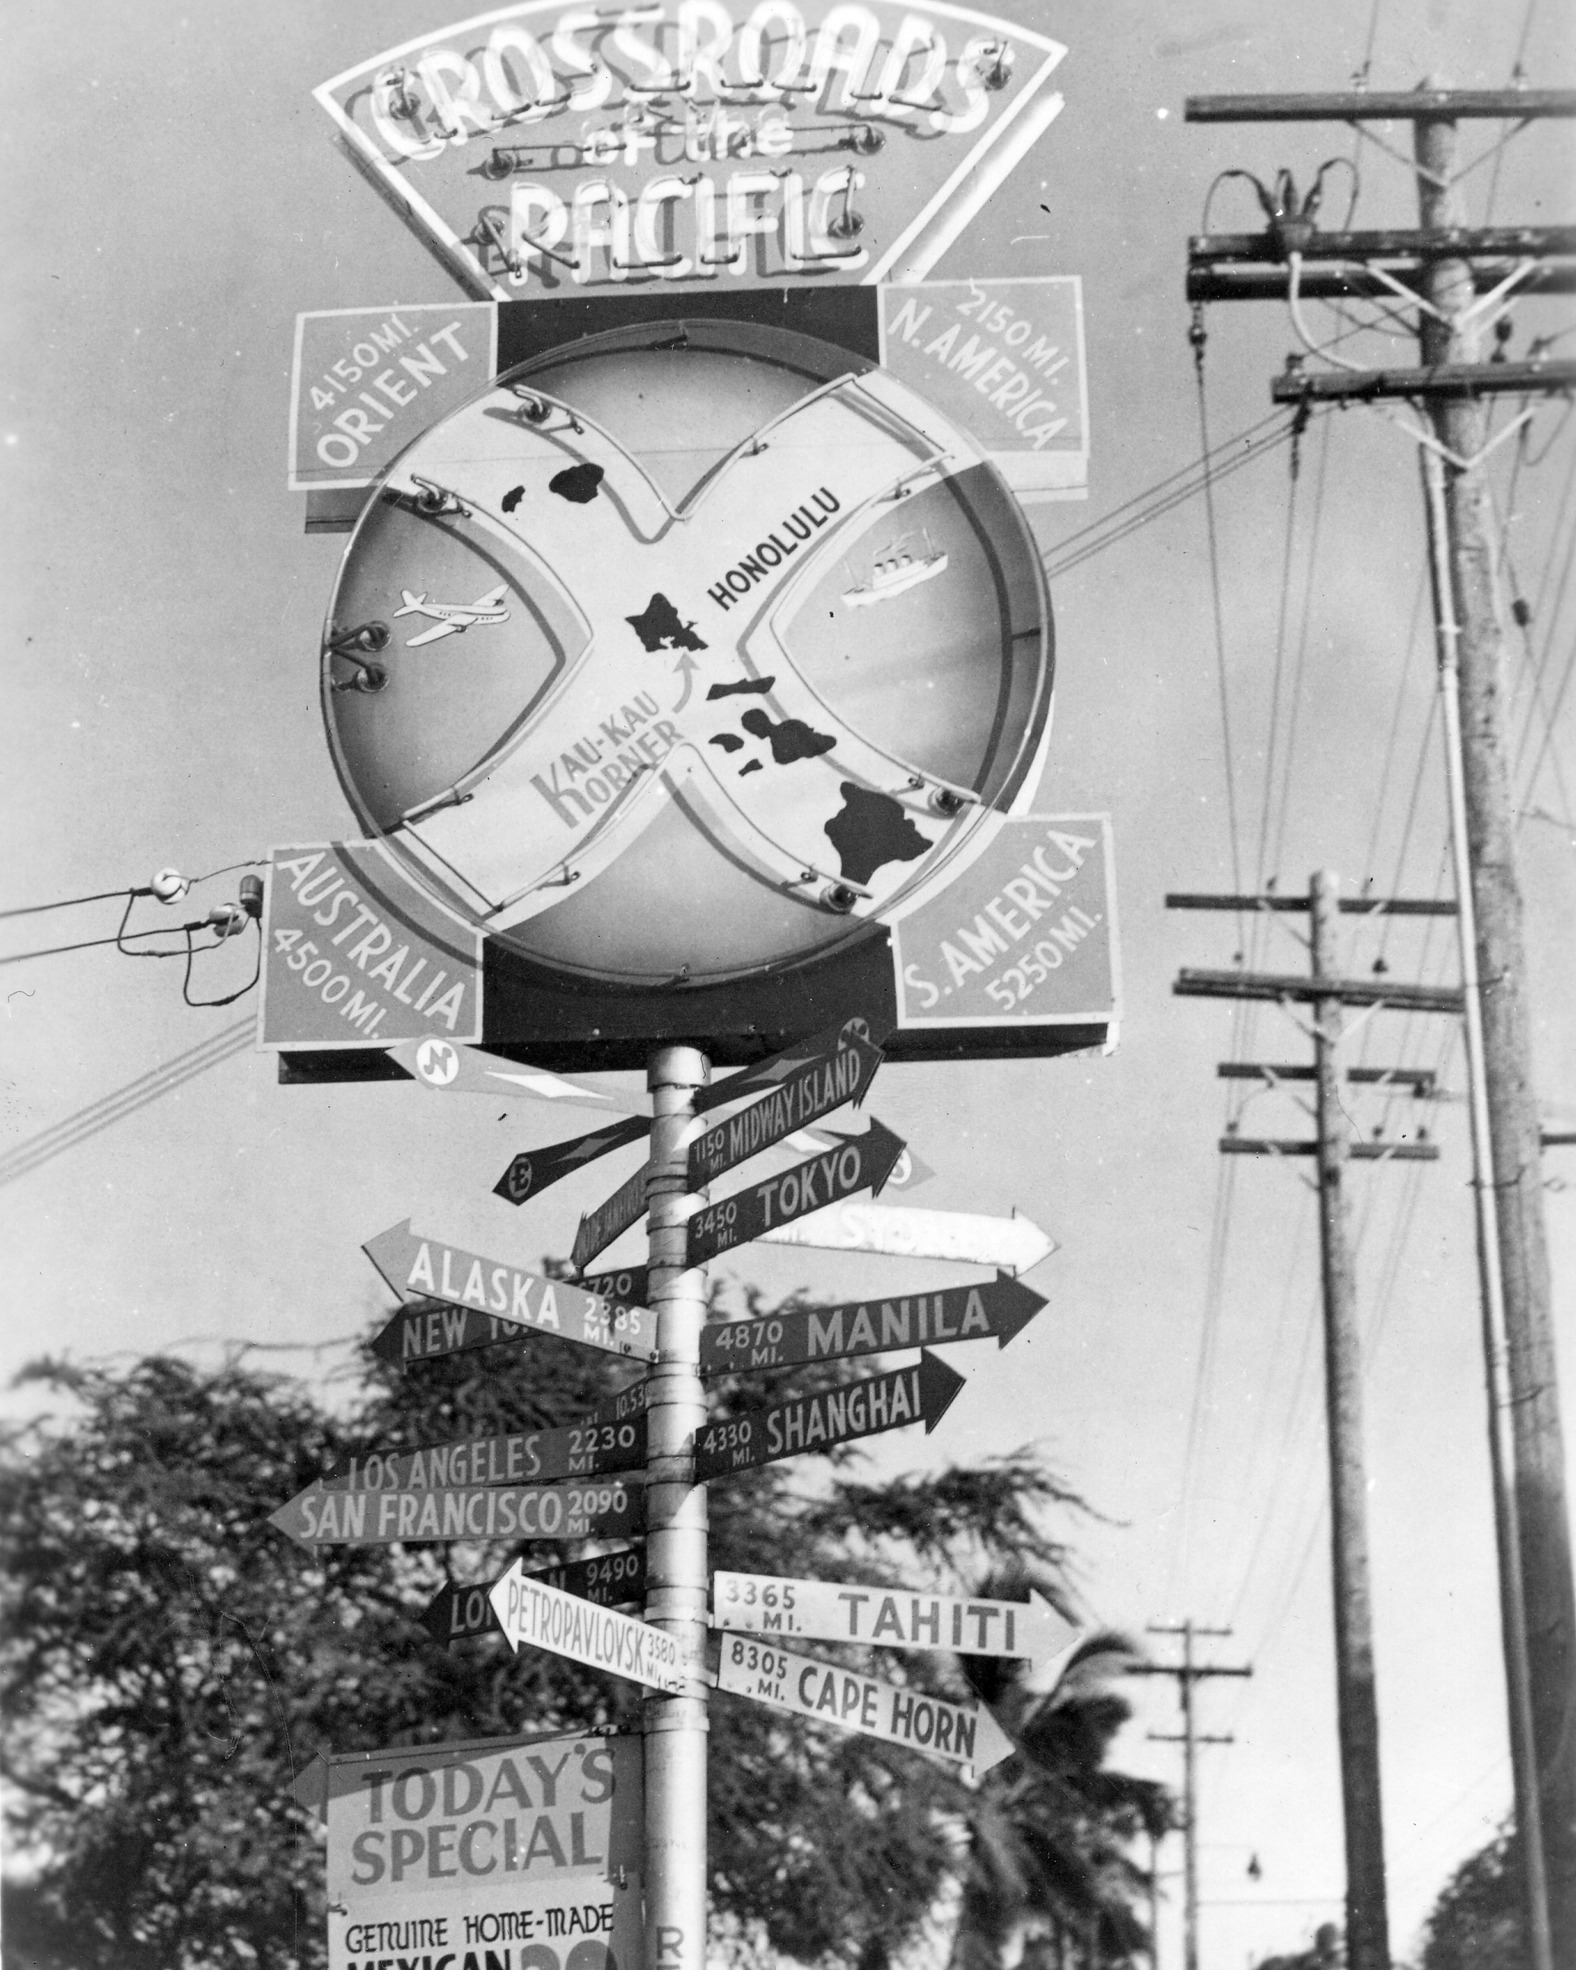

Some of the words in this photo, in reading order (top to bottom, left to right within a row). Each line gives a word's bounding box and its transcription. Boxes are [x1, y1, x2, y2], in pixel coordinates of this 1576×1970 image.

[370, 0, 1016, 161] CROSSROADS
[583, 103, 657, 166] of
[685, 103, 794, 162] the
[509, 170, 869, 286] PACIFIC
[955, 287, 1032, 346] 2150
[1021, 335, 1070, 386] MI.
[309, 342, 379, 410] 4150
[317, 321, 469, 468] ORIENT
[923, 323, 1068, 450] AMERICA
[706, 487, 841, 611] HONOLULU
[276, 852, 465, 1031] AUSTRALIA
[940, 829, 1098, 987] AMERICA
[273, 929, 350, 1004] 4500
[984, 940, 1063, 1011] 5250
[1049, 905, 1103, 951] MI.
[695, 1128, 725, 1163] 1150
[730, 1083, 795, 1161] MIDWAY
[799, 1048, 861, 1120] ISLAND
[695, 1201, 737, 1239] 3450
[757, 1146, 862, 1227] TOKYO
[710, 1154, 727, 1174] MI.
[717, 1228, 737, 1249] MI.
[406, 1242, 560, 1330] ALASKA
[584, 1297, 641, 1335] 2385
[715, 1320, 784, 1350] 4870
[807, 1288, 991, 1356] MANILA
[403, 1308, 468, 1358] NEW
[583, 1322, 614, 1346] MI.
[751, 1348, 784, 1366] MI.
[703, 1420, 752, 1455] 4330
[766, 1370, 921, 1454] SHANGHAI
[407, 1434, 541, 1490] ANGELES
[568, 1424, 636, 1454] 2230
[568, 1454, 600, 1472] MI.
[732, 1446, 755, 1468] MI.
[299, 1494, 366, 1539] SAN
[377, 1490, 562, 1538] FRANCISCO
[567, 1489, 627, 1516] 2090
[566, 1517, 596, 1534] MI.
[586, 1554, 639, 1587] 9490
[507, 1578, 644, 1677] PETROPAVLOVSK
[647, 1633, 676, 1666] 3580
[725, 1579, 796, 1610] 3365
[838, 1592, 1015, 1651] TAHITI
[762, 1611, 802, 1632] MI.
[731, 1640, 788, 1680] 8305
[798, 1665, 878, 1728] CAPE
[890, 1691, 977, 1759] HORN
[757, 1678, 785, 1701] MI.
[361, 1743, 616, 1824] TODAY'S
[350, 1811, 603, 1886] SPECIAL
[345, 1917, 448, 1954] GENUINE
[463, 1903, 615, 1944] HOME-MADE
